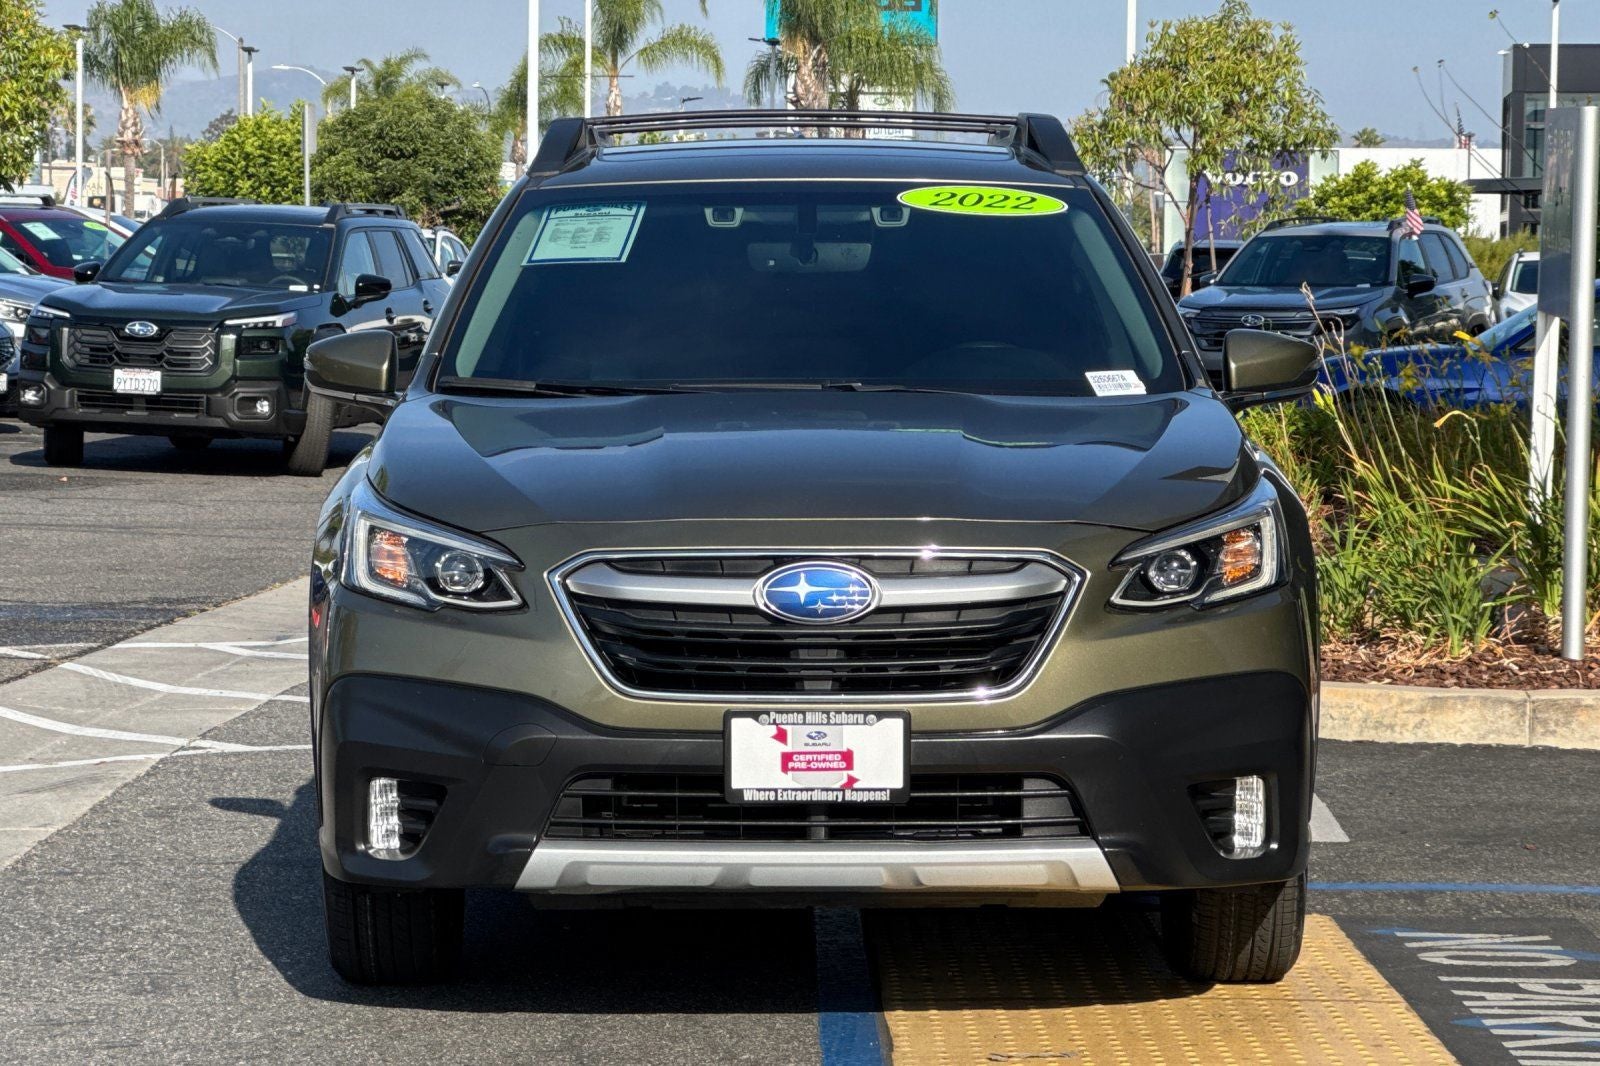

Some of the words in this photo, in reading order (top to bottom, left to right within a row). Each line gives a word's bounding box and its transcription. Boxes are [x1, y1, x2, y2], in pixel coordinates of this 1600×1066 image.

[929, 191, 1038, 210] 2022
[116, 377, 159, 391] 9YTD370
[769, 711, 804, 724] Puente
[805, 711, 827, 724] Hills
[829, 711, 864, 724] Subaru
[787, 761, 846, 769] PRE-OWNED
[743, 789, 776, 801] Where
[778, 789, 843, 802] Extraordinary
[844, 789, 890, 802] Happens!
[1393, 931, 1578, 967] NO
